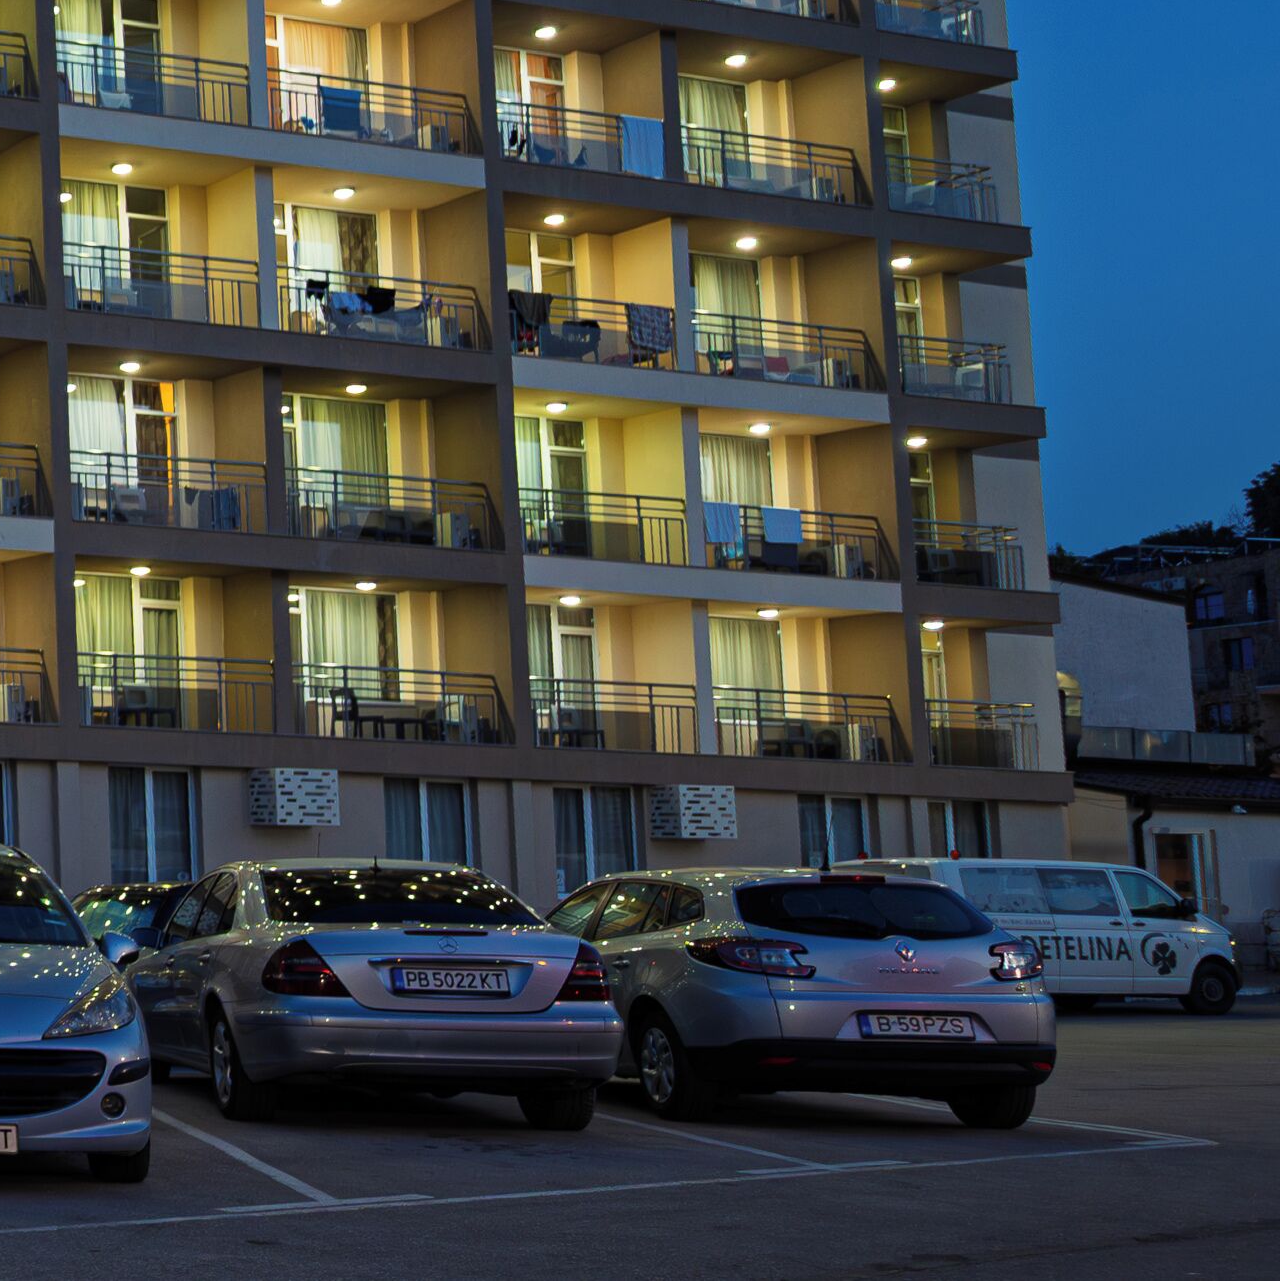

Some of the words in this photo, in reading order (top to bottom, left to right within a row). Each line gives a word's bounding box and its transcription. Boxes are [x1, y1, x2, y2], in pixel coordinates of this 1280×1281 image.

[405, 971, 430, 988] PB
[432, 972, 478, 989] 5022
[479, 973, 503, 989] KT
